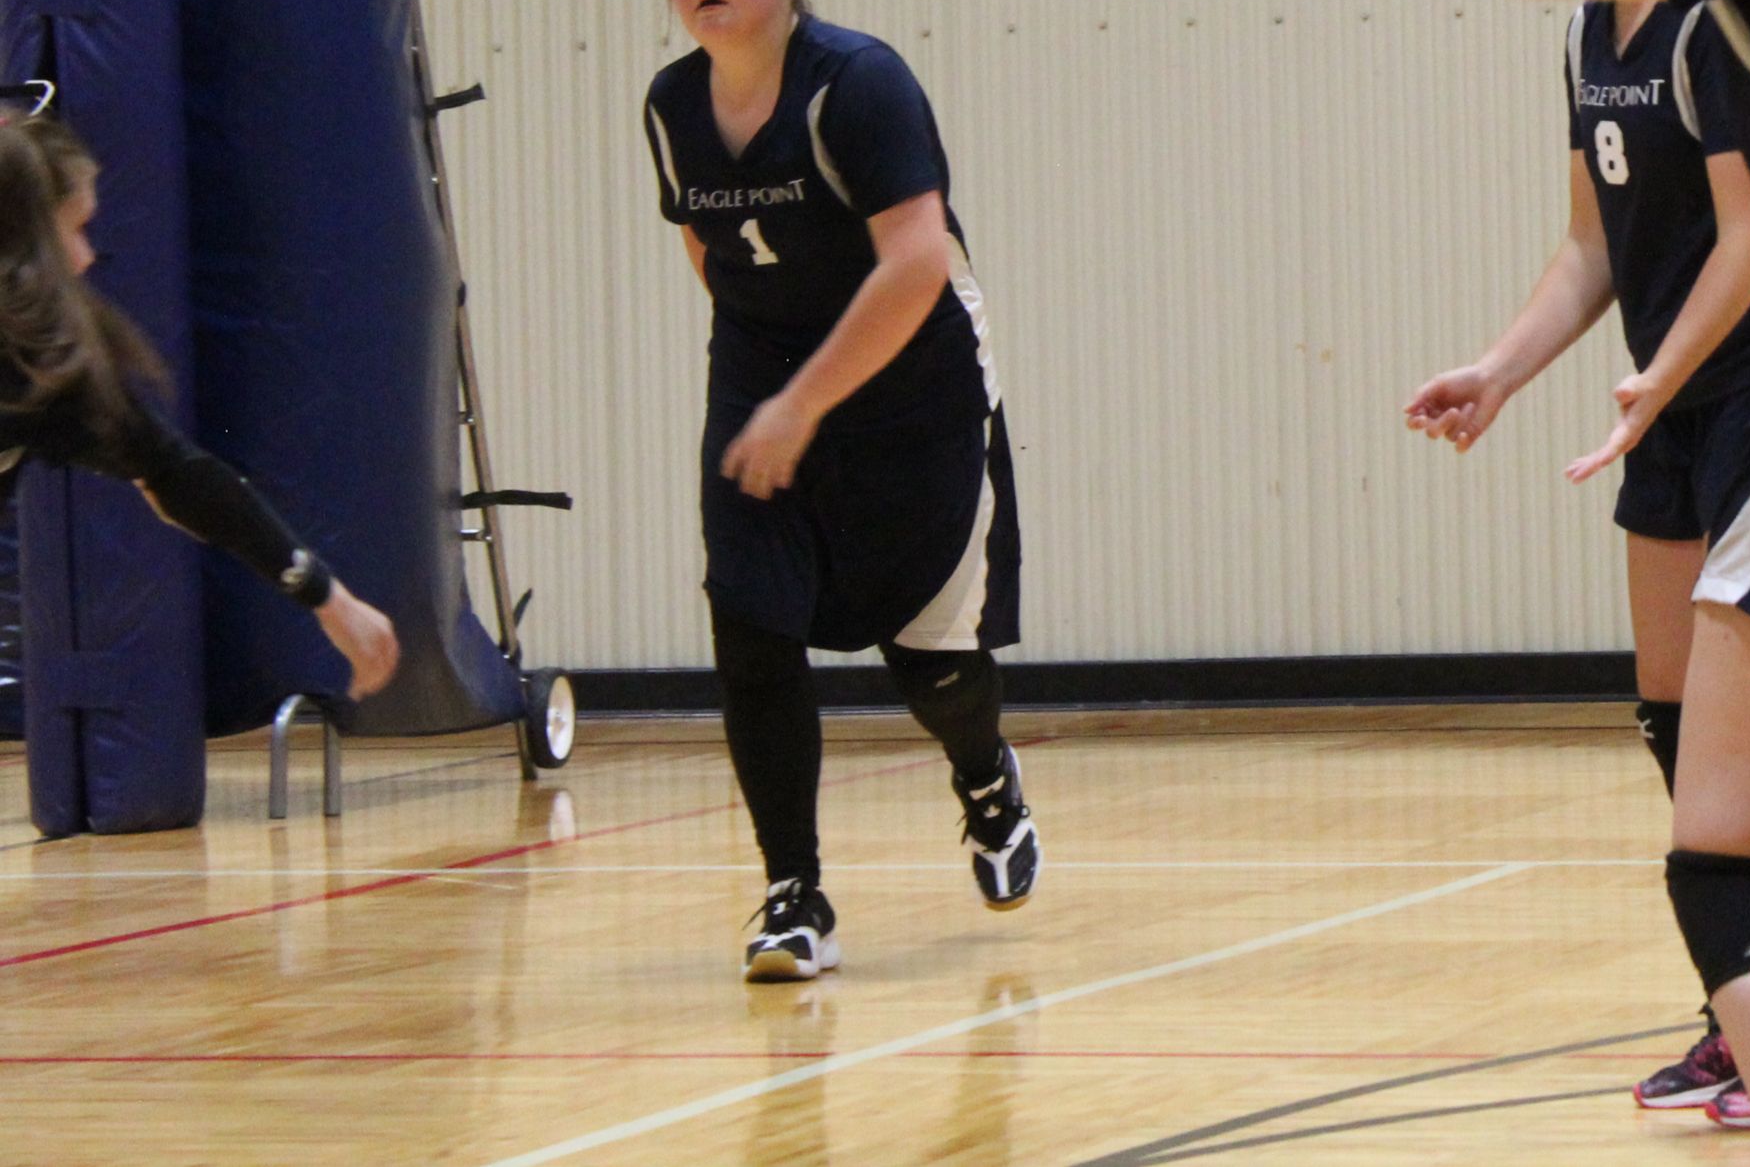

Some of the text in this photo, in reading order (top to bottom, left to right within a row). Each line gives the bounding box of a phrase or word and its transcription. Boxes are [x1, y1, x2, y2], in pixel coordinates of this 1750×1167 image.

[1608, 78, 1666, 107] POINT
[1594, 120, 1630, 185] 8
[687, 178, 805, 210] EAGLE POINT
[740, 218, 779, 266] 1
